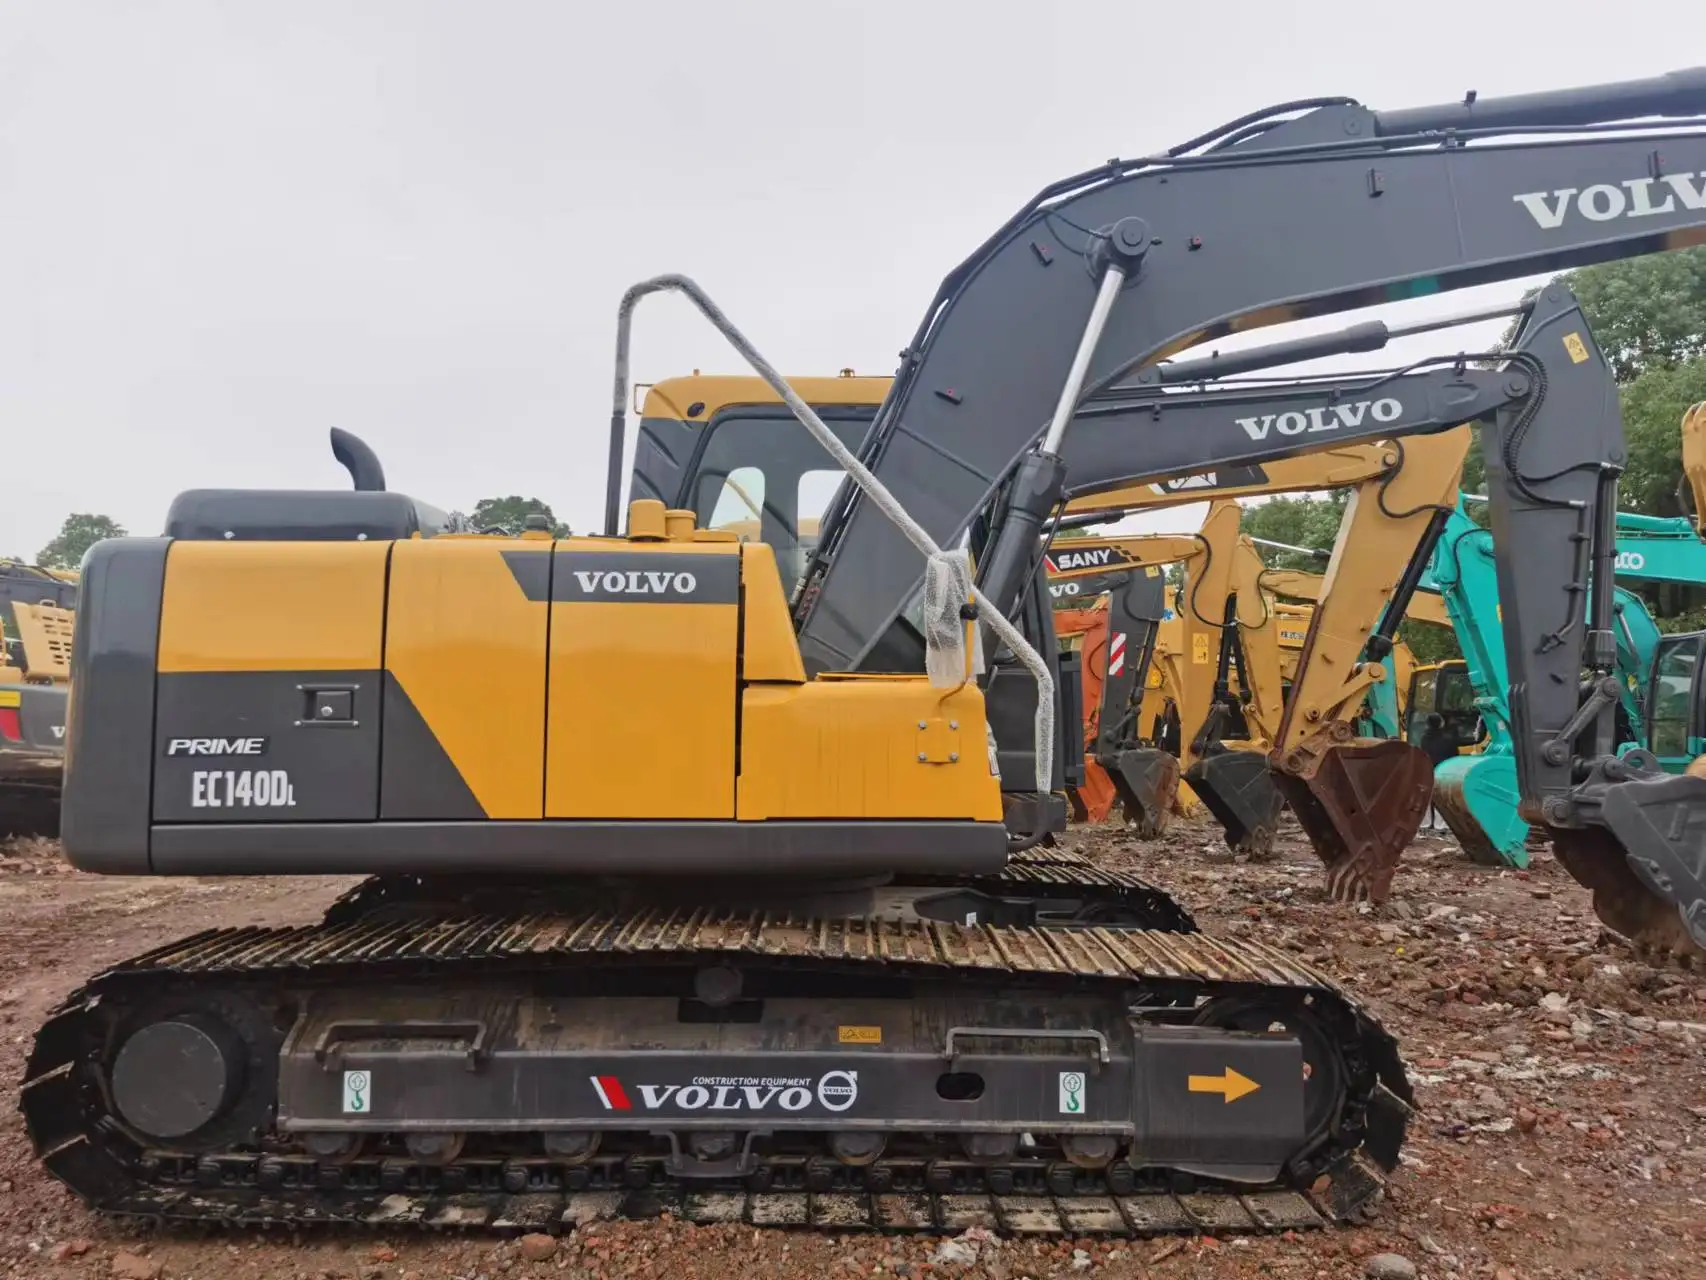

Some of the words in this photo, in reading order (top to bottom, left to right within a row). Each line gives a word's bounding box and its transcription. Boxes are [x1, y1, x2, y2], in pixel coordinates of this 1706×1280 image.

[1235, 398, 1403, 440] VOLVO
[1058, 549, 1111, 569] SANY
[573, 571, 696, 593] VOLVO
[168, 738, 264, 755] PRIME
[692, 1077, 759, 1085] CONSTRUCTION
[761, 1078, 811, 1086] EQUIPMENT
[637, 1085, 813, 1110] VOLVO
